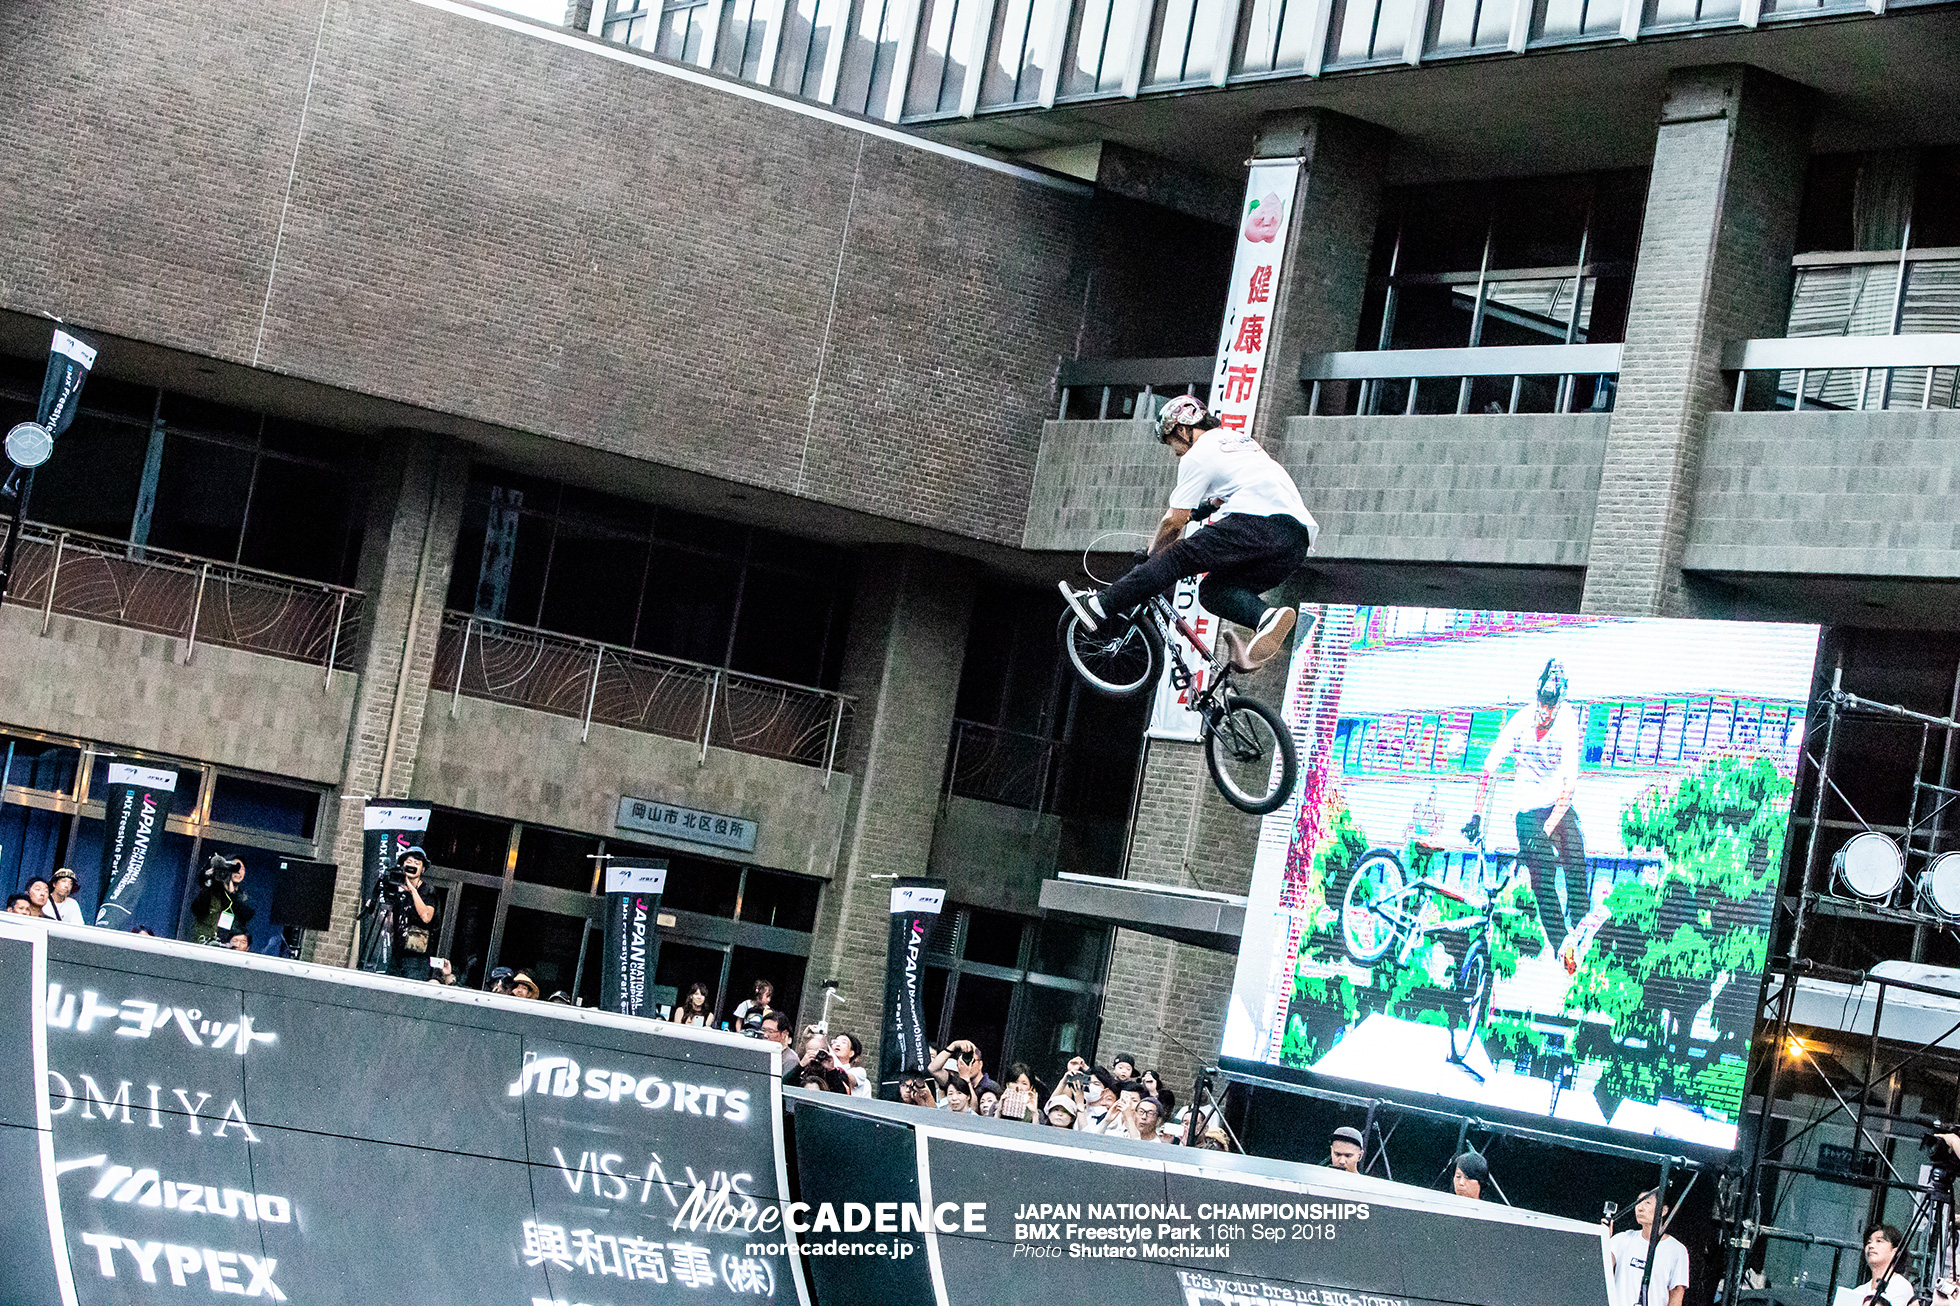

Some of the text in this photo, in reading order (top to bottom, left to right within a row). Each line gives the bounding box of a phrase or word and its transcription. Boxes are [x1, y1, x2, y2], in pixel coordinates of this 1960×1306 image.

[65, 364, 73, 386] BMX
[46, 387, 70, 432] Freestyle
[122, 790, 135, 811] BMX
[131, 793, 157, 849] JAPAN
[631, 802, 744, 838] 岡山市北区役所
[114, 811, 131, 854] Freestyle
[379, 834, 389, 856] BMX
[110, 854, 121, 876] Park
[127, 846, 148, 885] NATIONAL
[630, 898, 648, 962] JAPAN
[905, 920, 924, 991] JAPAN
[620, 974, 629, 999] Park
[635, 960, 645, 1007] NATIONAL
[508, 1051, 750, 1122] JTB SPORTS
[82, 1232, 288, 1301] TYPEX
[1180, 1272, 1212, 1290] It's
[1214, 1279, 1258, 1299] your
